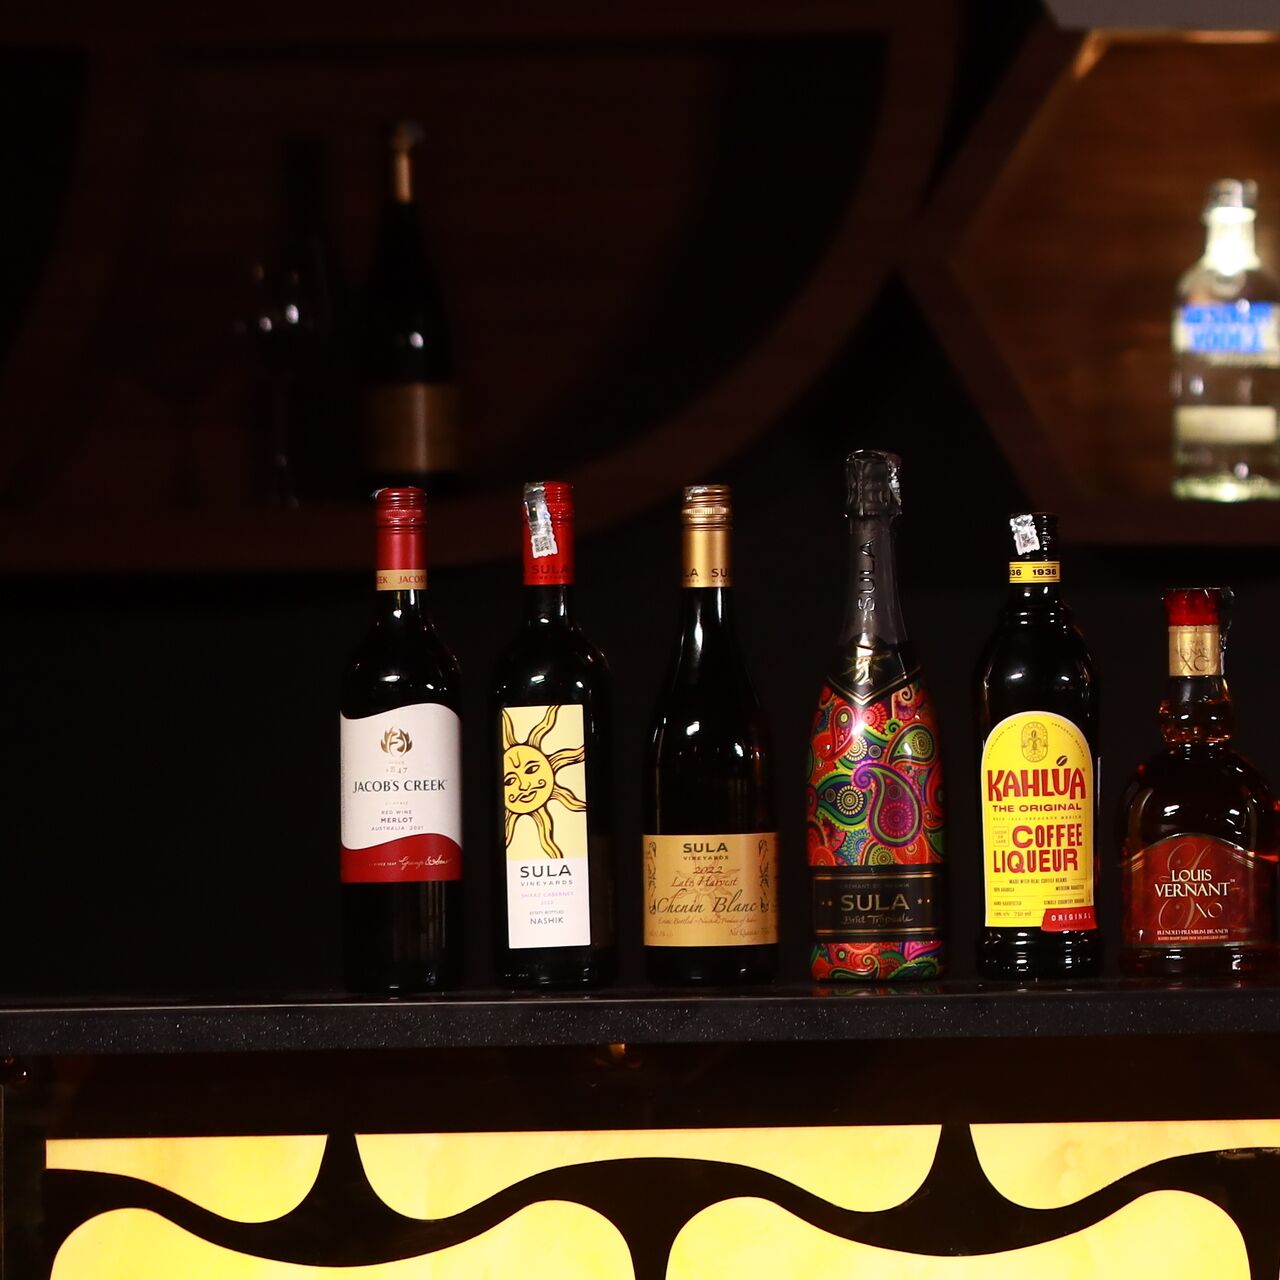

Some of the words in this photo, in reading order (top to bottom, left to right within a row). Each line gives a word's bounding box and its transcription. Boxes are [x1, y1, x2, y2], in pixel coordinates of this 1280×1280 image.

[531, 564, 570, 575] SULA
[858, 537, 877, 611] SULA
[1032, 568, 1057, 576] 1936
[353, 779, 400, 793] JACOB'S
[404, 778, 447, 791] CREEK
[992, 805, 1015, 813] THE
[1019, 803, 1082, 813] ORIGINAL
[1012, 823, 1083, 849] COFFEE
[683, 842, 729, 853] SULA
[993, 848, 1078, 874] LIQUEUR
[519, 864, 572, 878] SULA
[693, 866, 723, 874] 2022
[1171, 869, 1212, 882] LOUIS
[697, 875, 738, 887] Harvest
[1154, 882, 1231, 898] VERNANT
[657, 888, 705, 914] Chenin
[711, 888, 757, 914] Blanc
[840, 893, 911, 912] SULA
[530, 916, 564, 925] NASHIK
[1051, 912, 1092, 922] ORIGINAL
